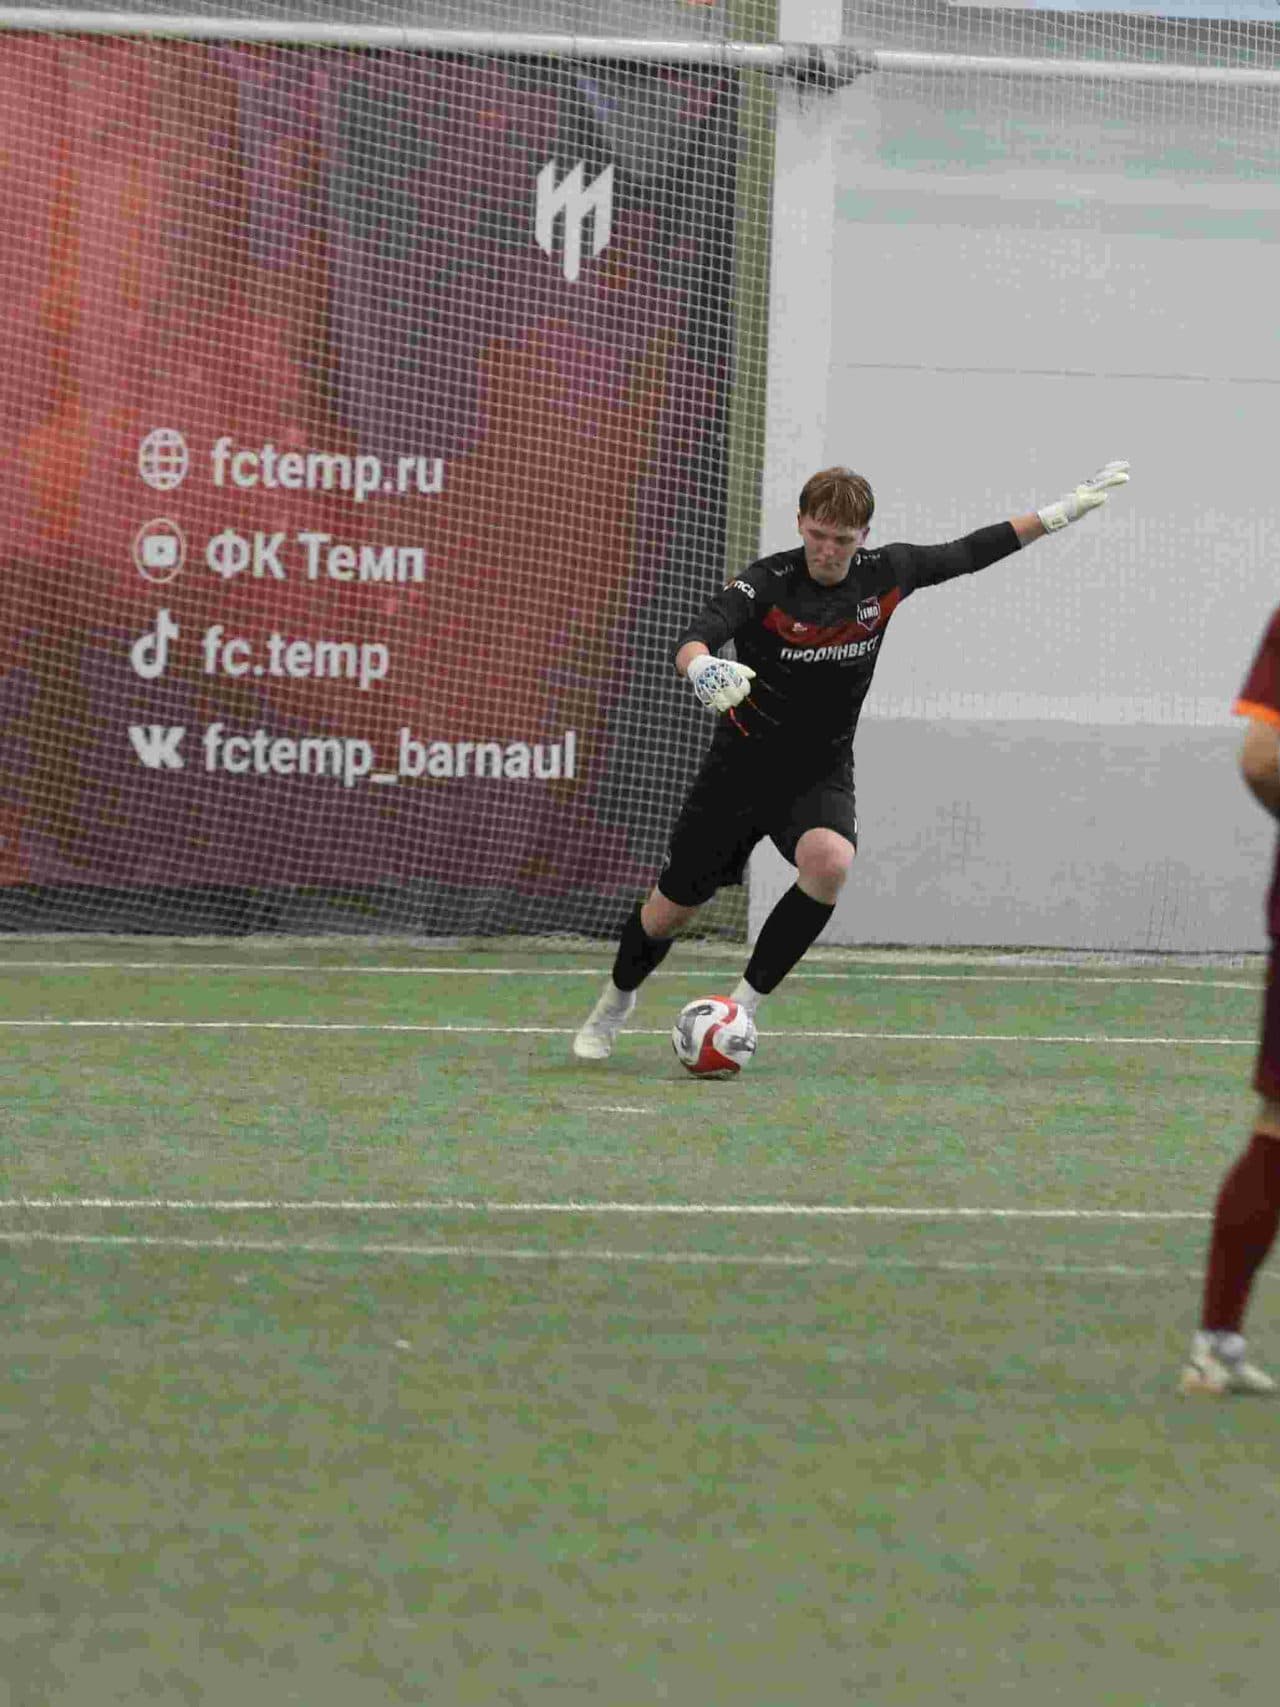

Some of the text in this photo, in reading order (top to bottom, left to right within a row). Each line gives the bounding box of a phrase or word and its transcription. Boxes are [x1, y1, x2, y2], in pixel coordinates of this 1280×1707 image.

[211, 437, 444, 501] fctemp.ru
[206, 529, 426, 582] ФК Темп
[202, 626, 390, 690] fc.temp
[201, 723, 577, 788] fctemp_barnaul
